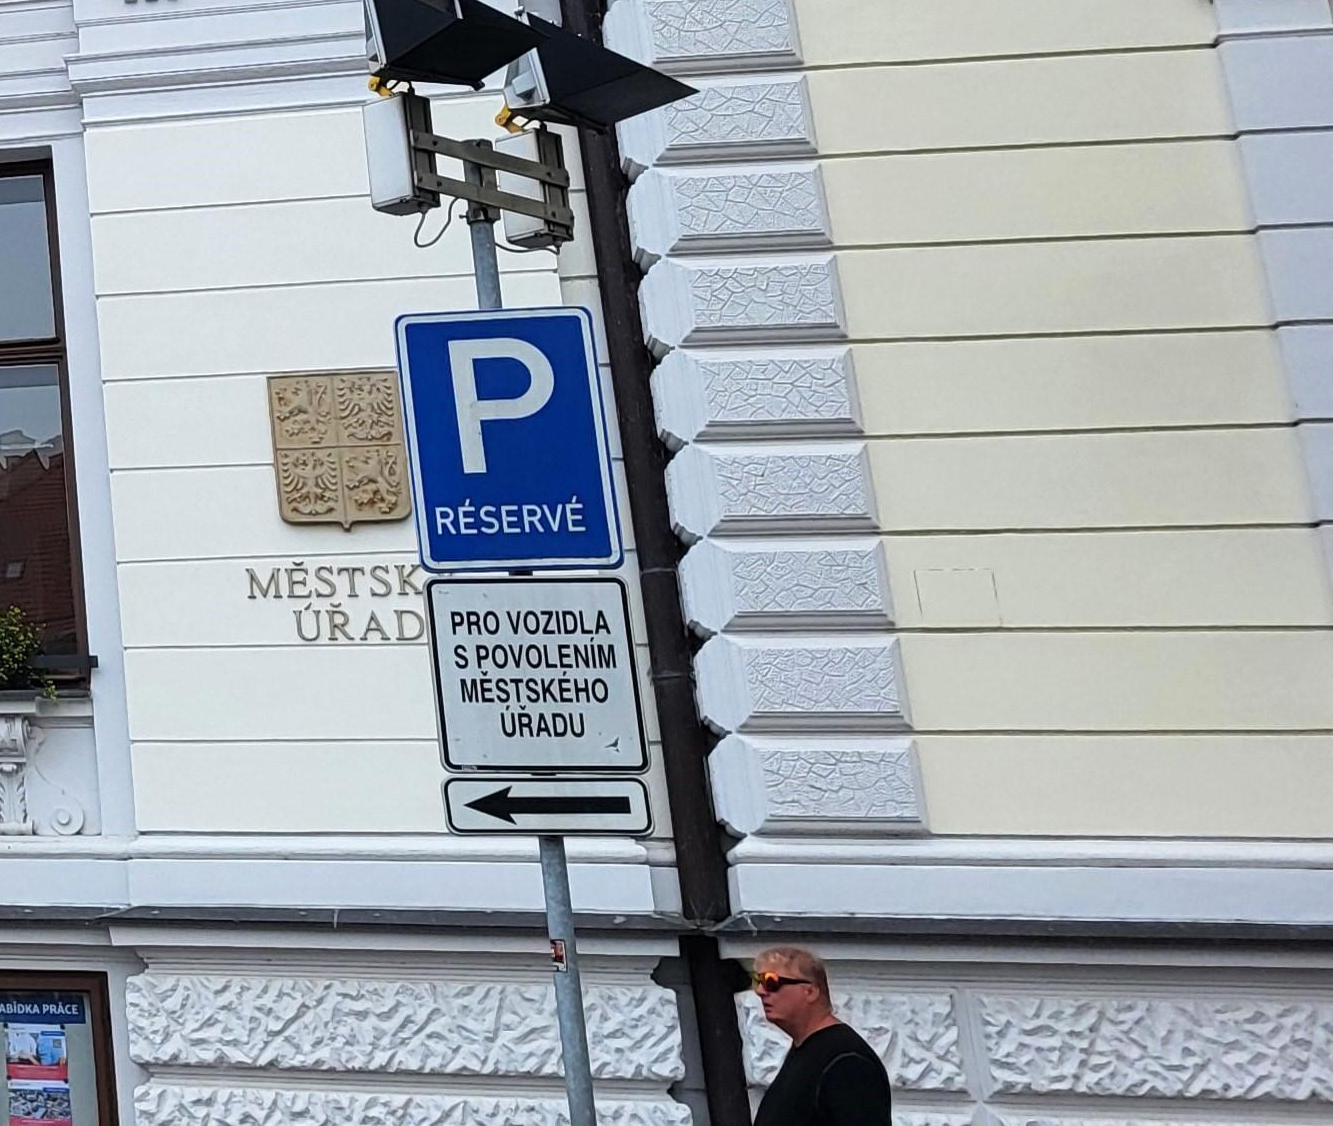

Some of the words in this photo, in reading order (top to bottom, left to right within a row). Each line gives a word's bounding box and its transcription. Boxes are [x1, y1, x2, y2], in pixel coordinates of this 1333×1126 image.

[447, 337, 555, 474] P
[435, 495, 586, 535] RÉSERVÉ
[245, 561, 424, 600] MĚSTSK
[293, 602, 425, 642] ÚŘAD
[450, 610, 501, 636] PRO
[506, 609, 612, 635] VOZIDLA
[453, 644, 469, 670] S
[475, 636, 617, 670] POVOLENÍM
[459, 670, 610, 704] MĚSTSKÉHO
[500, 705, 585, 739] ÚŘADU
[42, 1001, 79, 1015] PRÁCE
